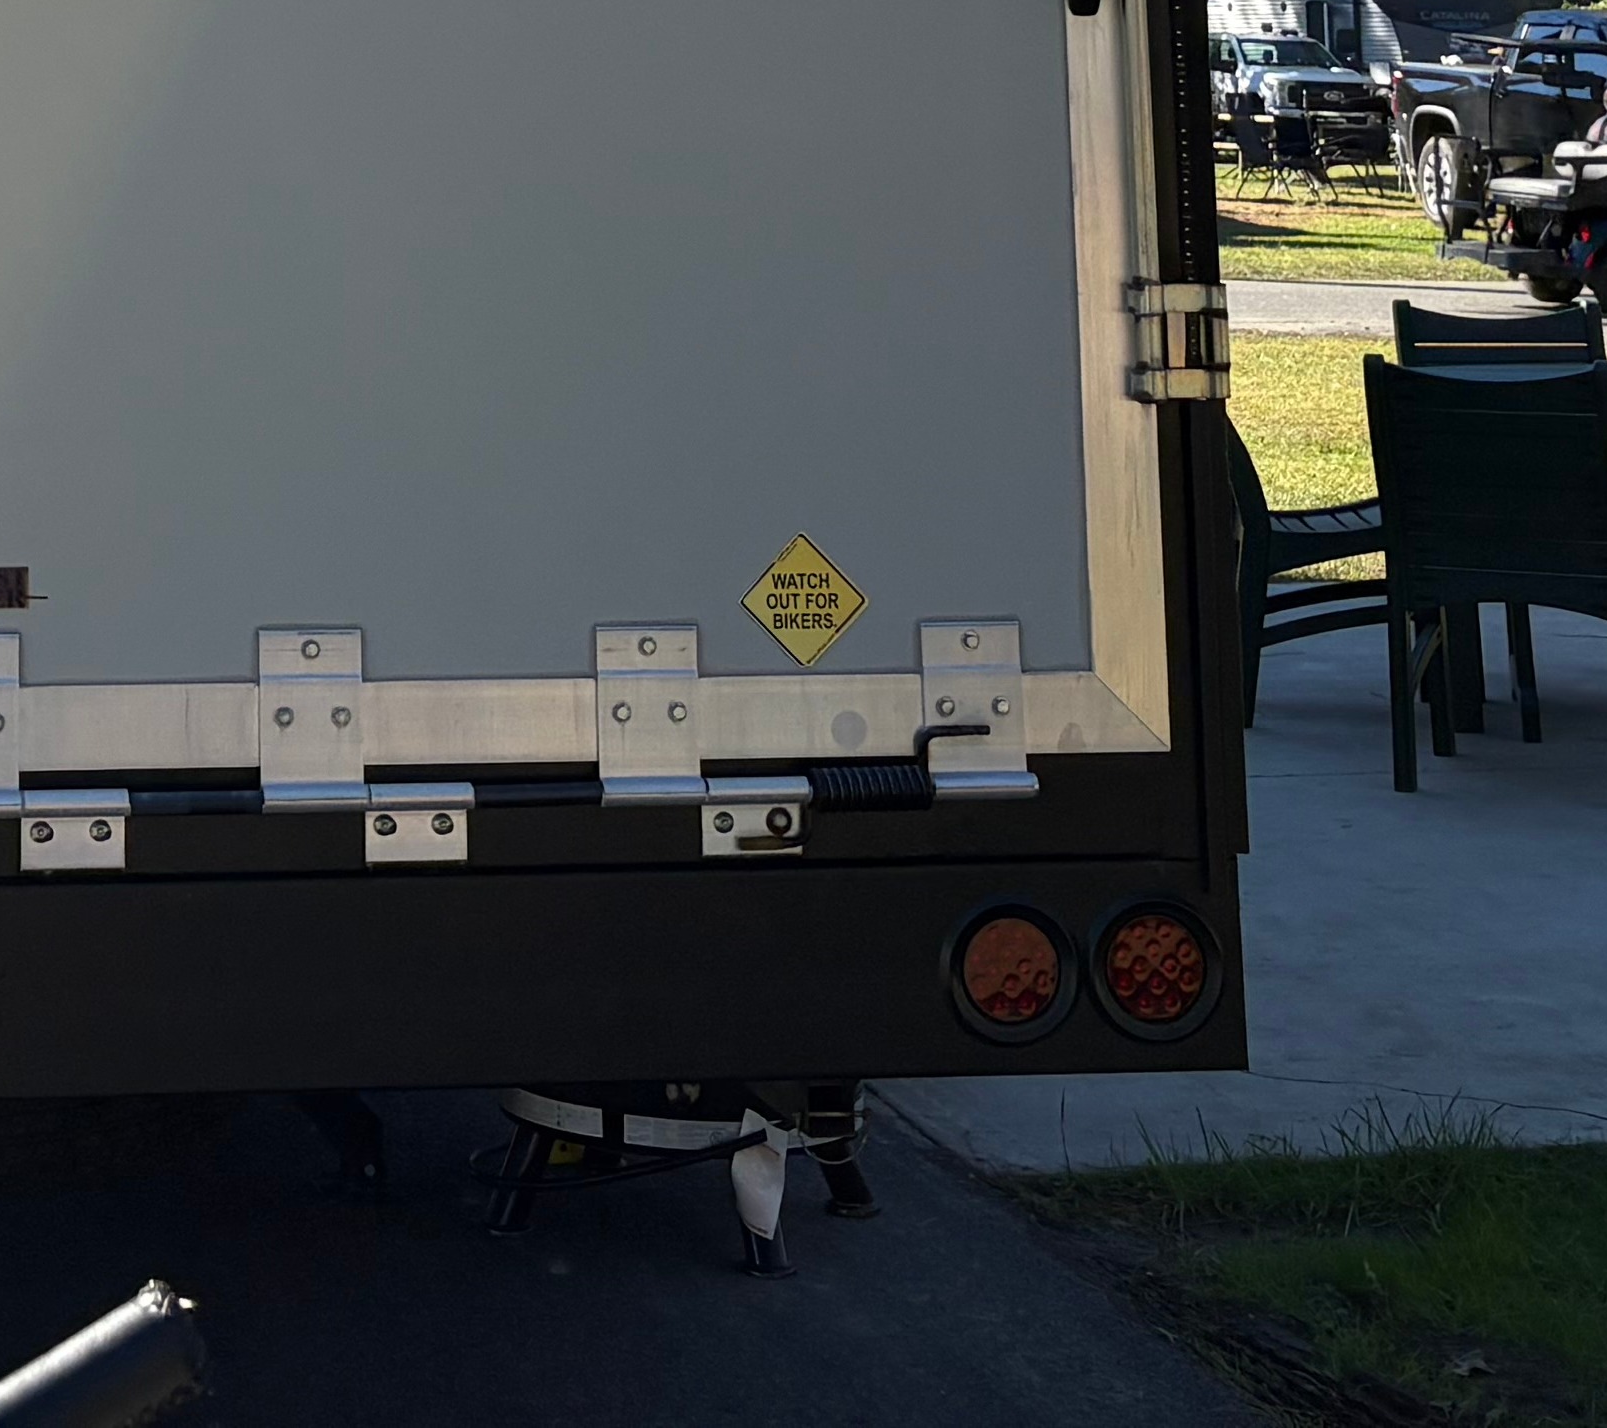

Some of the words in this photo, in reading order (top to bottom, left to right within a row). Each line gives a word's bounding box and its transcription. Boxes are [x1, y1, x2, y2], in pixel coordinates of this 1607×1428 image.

[1419, 11, 1490, 21] CATALINA
[771, 572, 830, 590] WATCH
[766, 593, 800, 610] OUT
[805, 592, 839, 609] FOR
